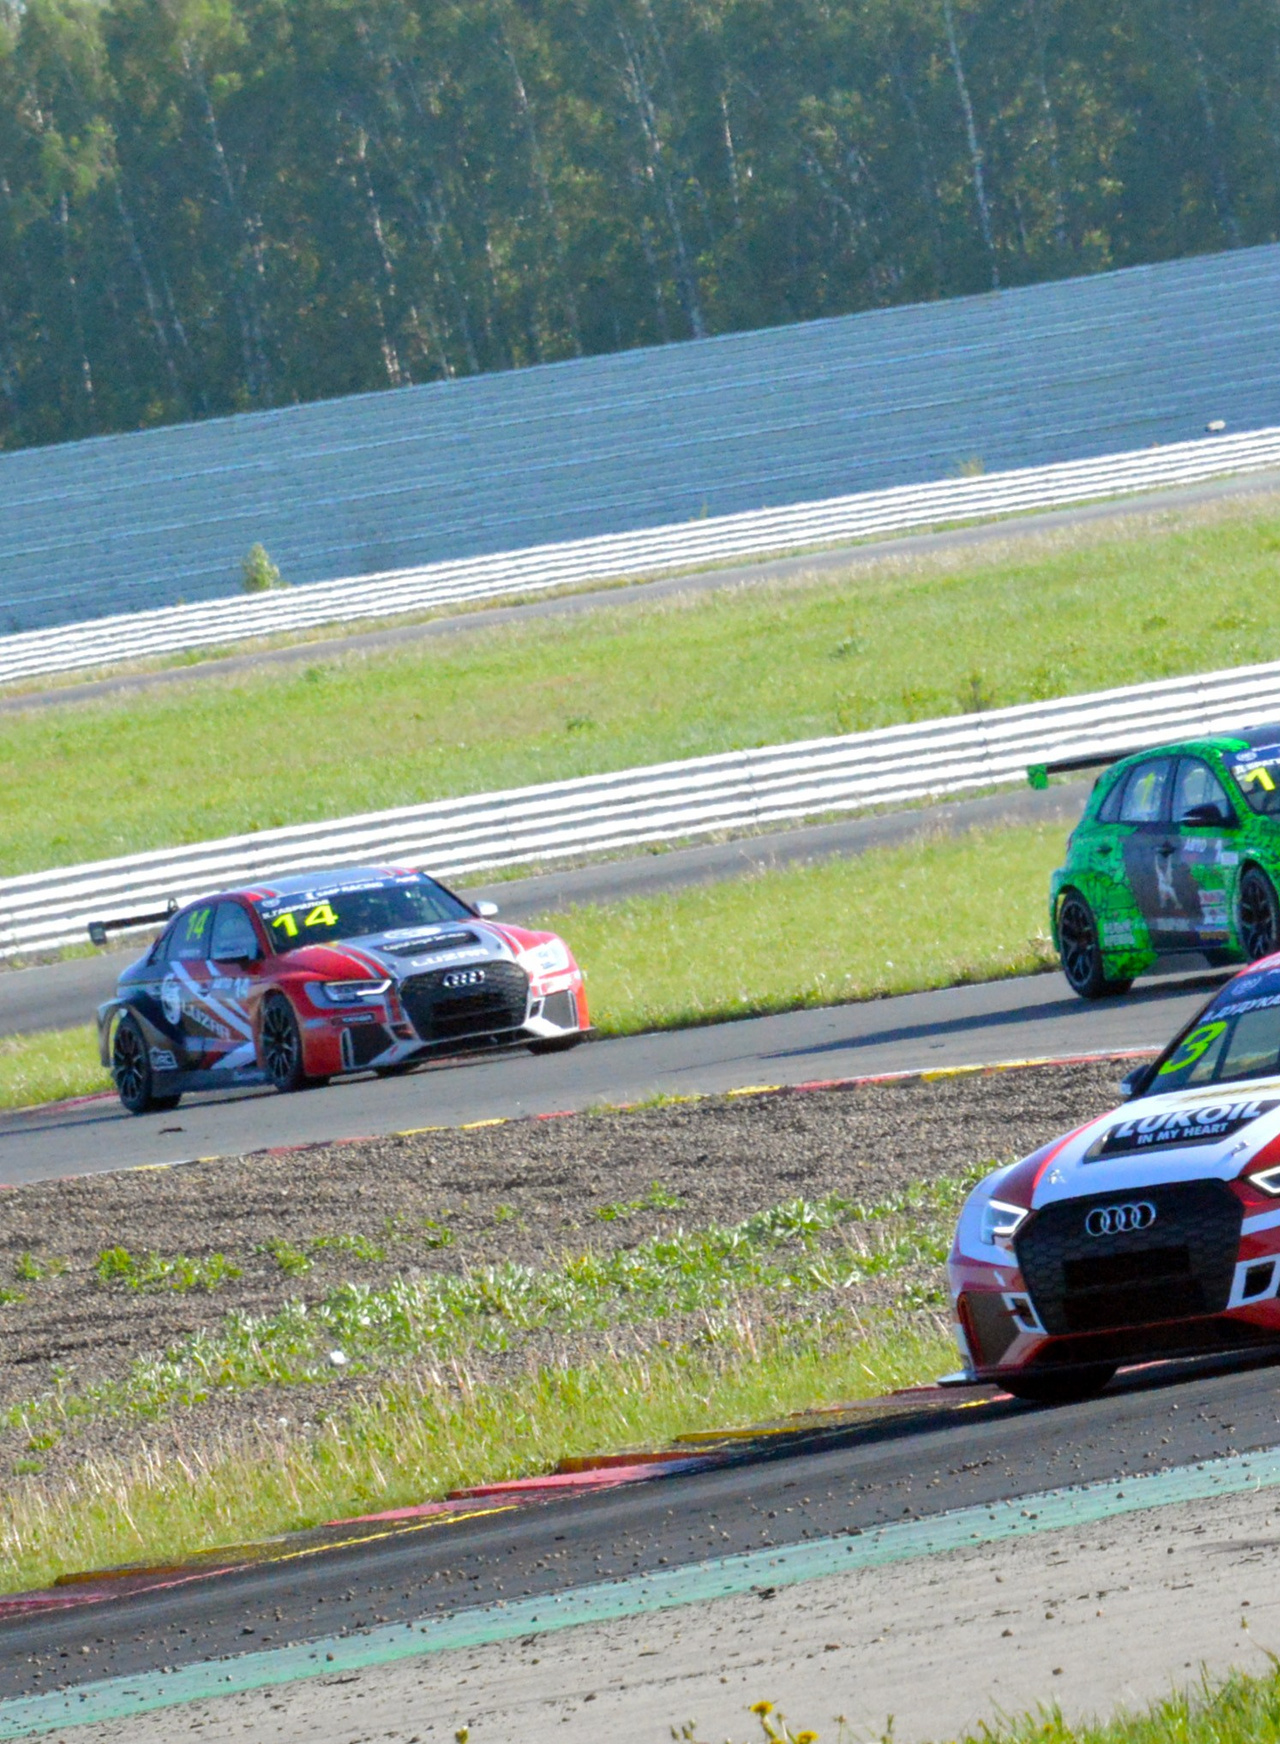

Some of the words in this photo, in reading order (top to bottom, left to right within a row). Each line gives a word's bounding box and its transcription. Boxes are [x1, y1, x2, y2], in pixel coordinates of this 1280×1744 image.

[1244, 766, 1276, 791] 1
[272, 904, 339, 937] 14
[1157, 1020, 1228, 1076] 3
[1114, 1100, 1263, 1139] LUKOIL
[1137, 1133, 1152, 1145] IN
[1156, 1129, 1179, 1142] MY
[1183, 1122, 1229, 1138] HEART
